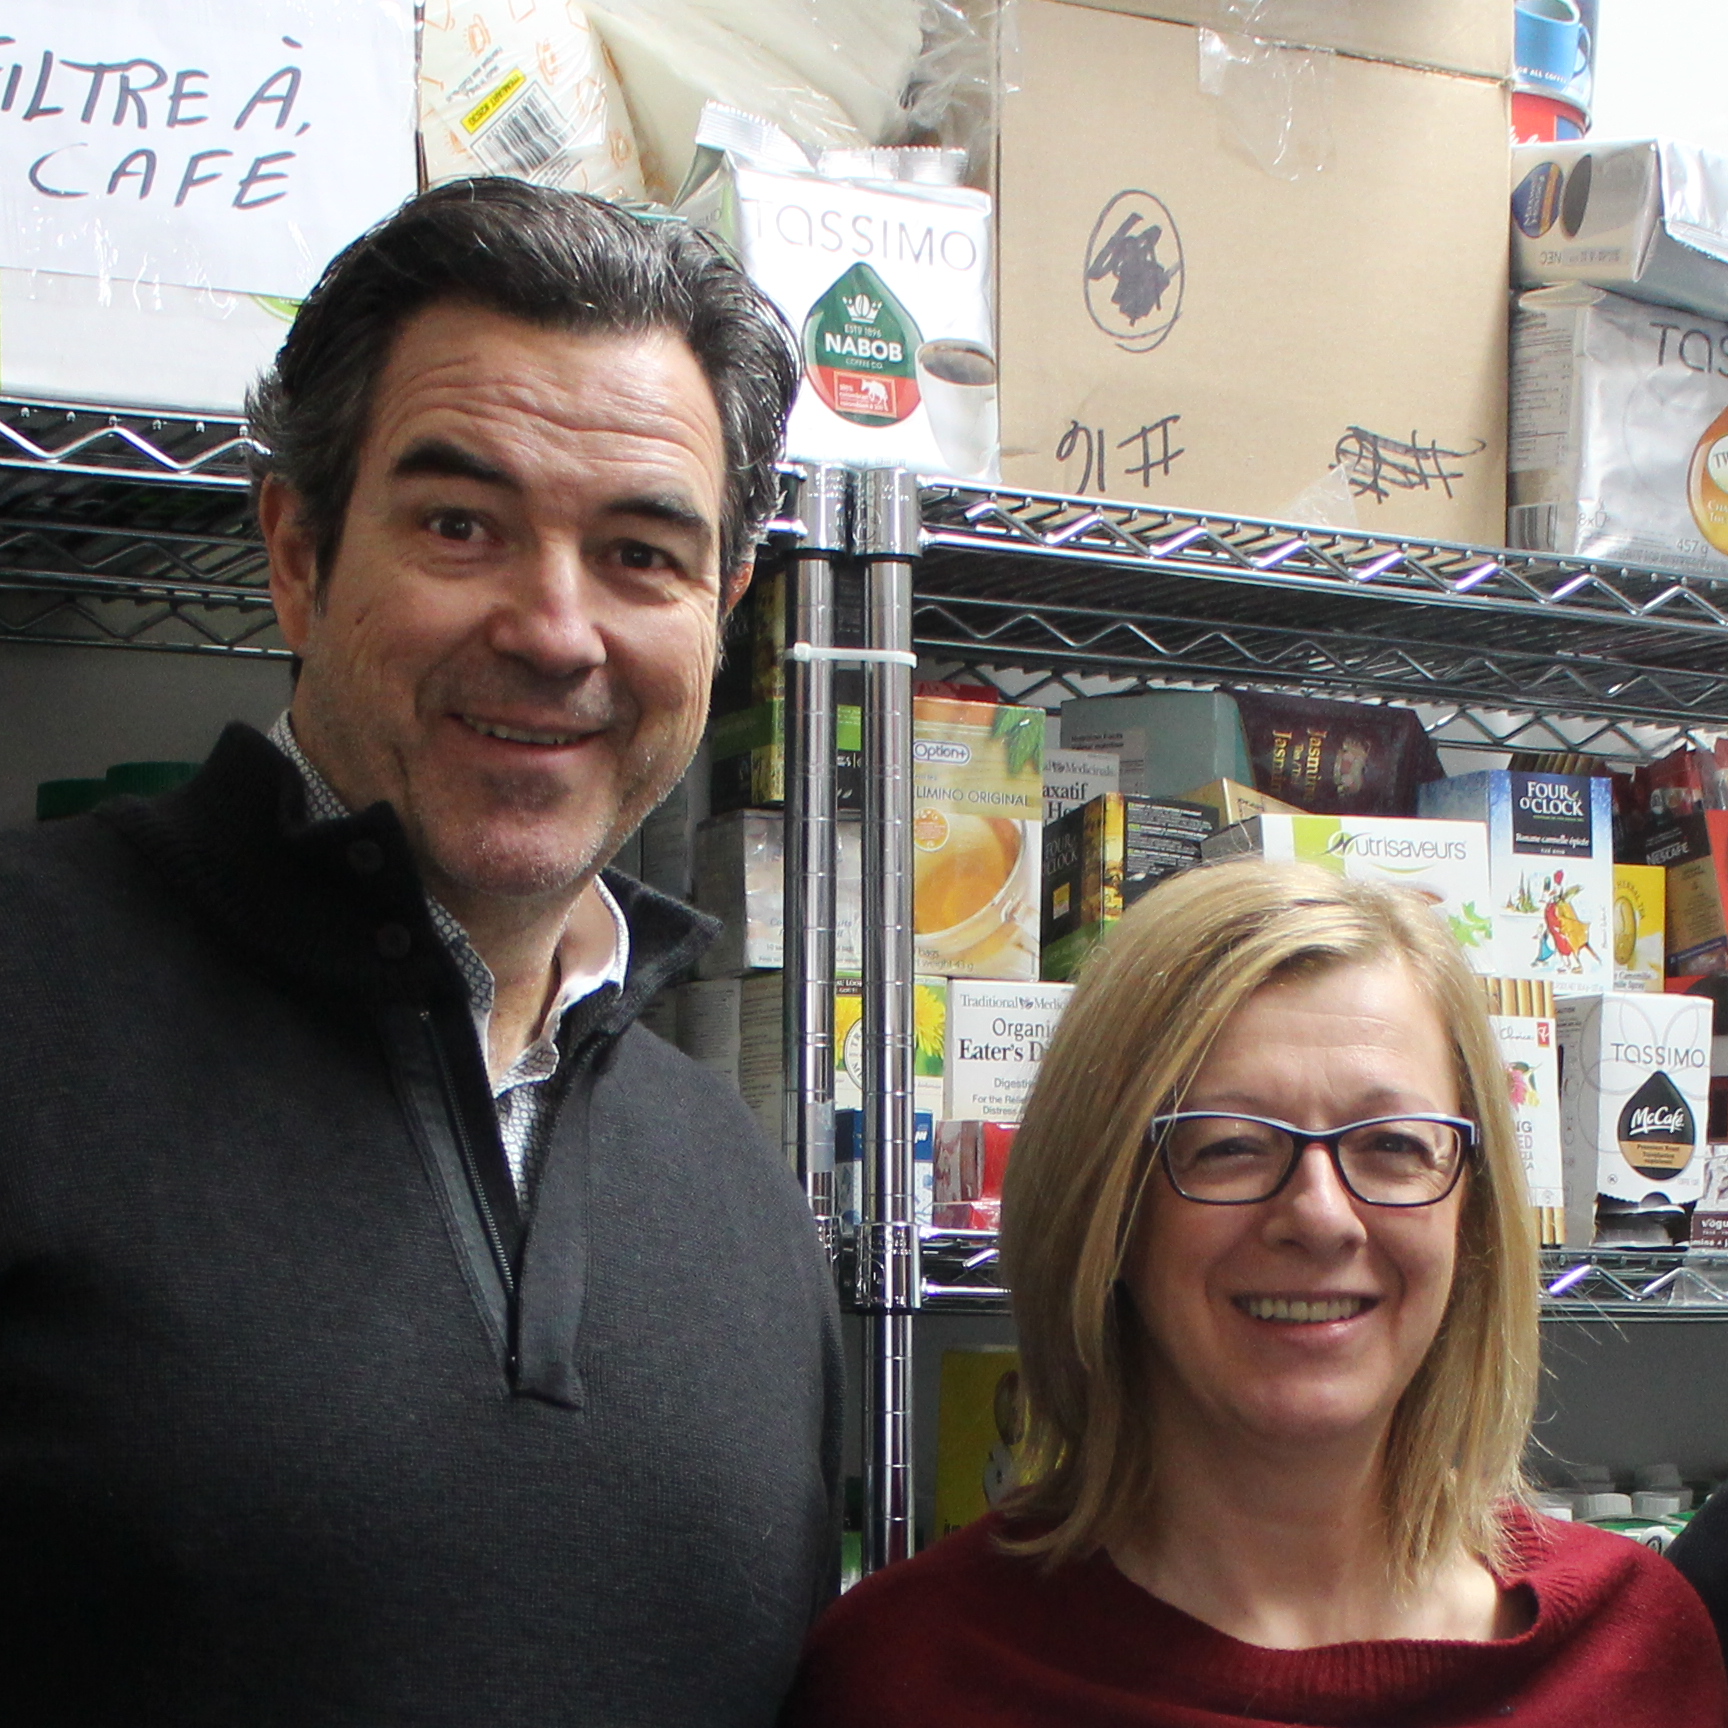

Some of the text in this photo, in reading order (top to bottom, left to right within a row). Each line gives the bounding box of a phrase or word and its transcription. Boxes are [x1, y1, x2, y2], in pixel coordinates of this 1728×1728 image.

[825, 332, 903, 362] NABOB
[1676, 539, 1698, 552] 457
[915, 742, 968, 763] Option+
[967, 791, 1030, 807] ORIGINAL
[1527, 780, 1569, 800] FOUR
[1520, 796, 1584, 818] O'CLOCK
[1320, 830, 1467, 861] Nutrisaveurs
[960, 993, 1019, 1009] Traditional
[958, 1039, 1024, 1062] Eater's
[1630, 1106, 1684, 1133] McCafé
